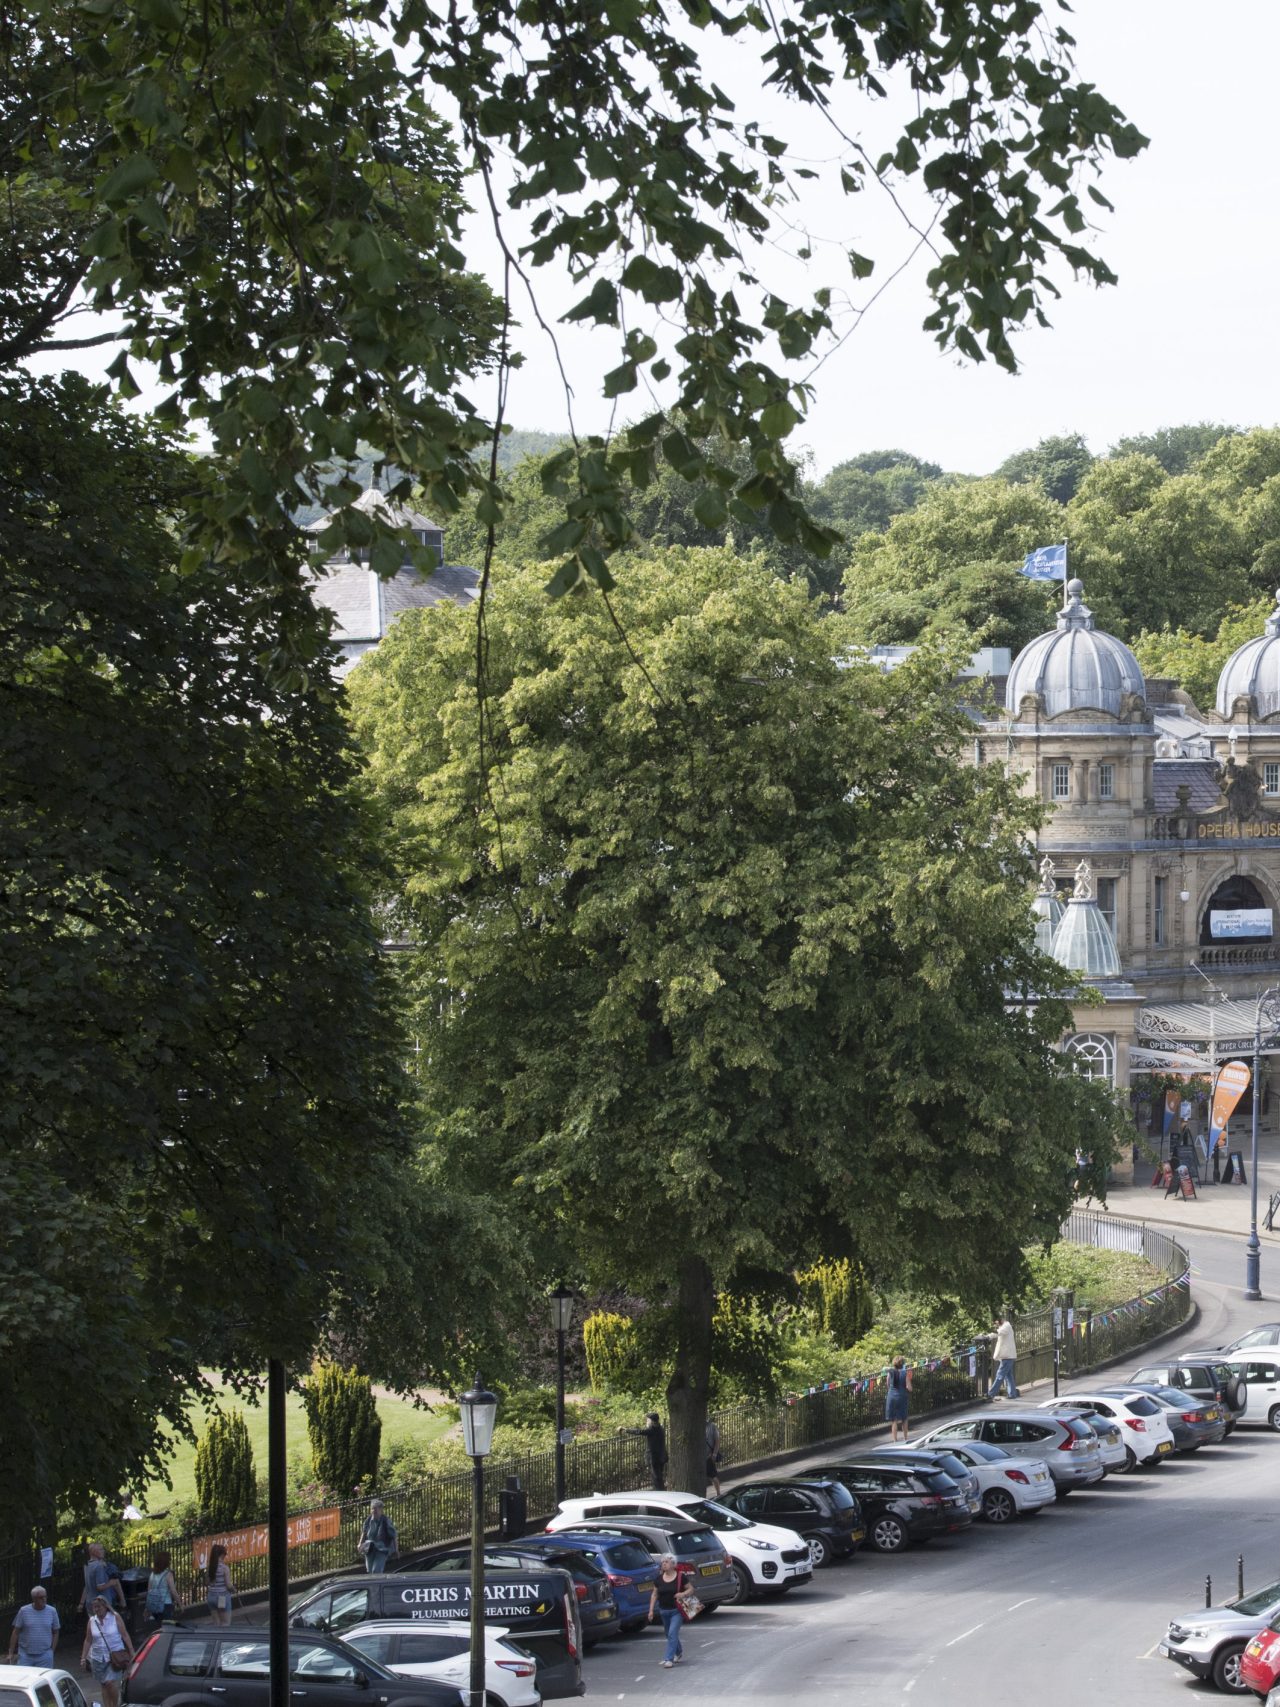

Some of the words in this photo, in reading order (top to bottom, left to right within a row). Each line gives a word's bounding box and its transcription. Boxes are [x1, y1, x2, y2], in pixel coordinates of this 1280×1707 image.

[1198, 824, 1240, 838] OPERA
[1149, 1041, 1176, 1050] OPERA
[1219, 1042, 1237, 1050] UPPER
[296, 1516, 312, 1528] THIS
[401, 1587, 458, 1603] CHRIS
[411, 1608, 468, 1619] PLUMBING
[484, 1606, 531, 1617] HEATING
